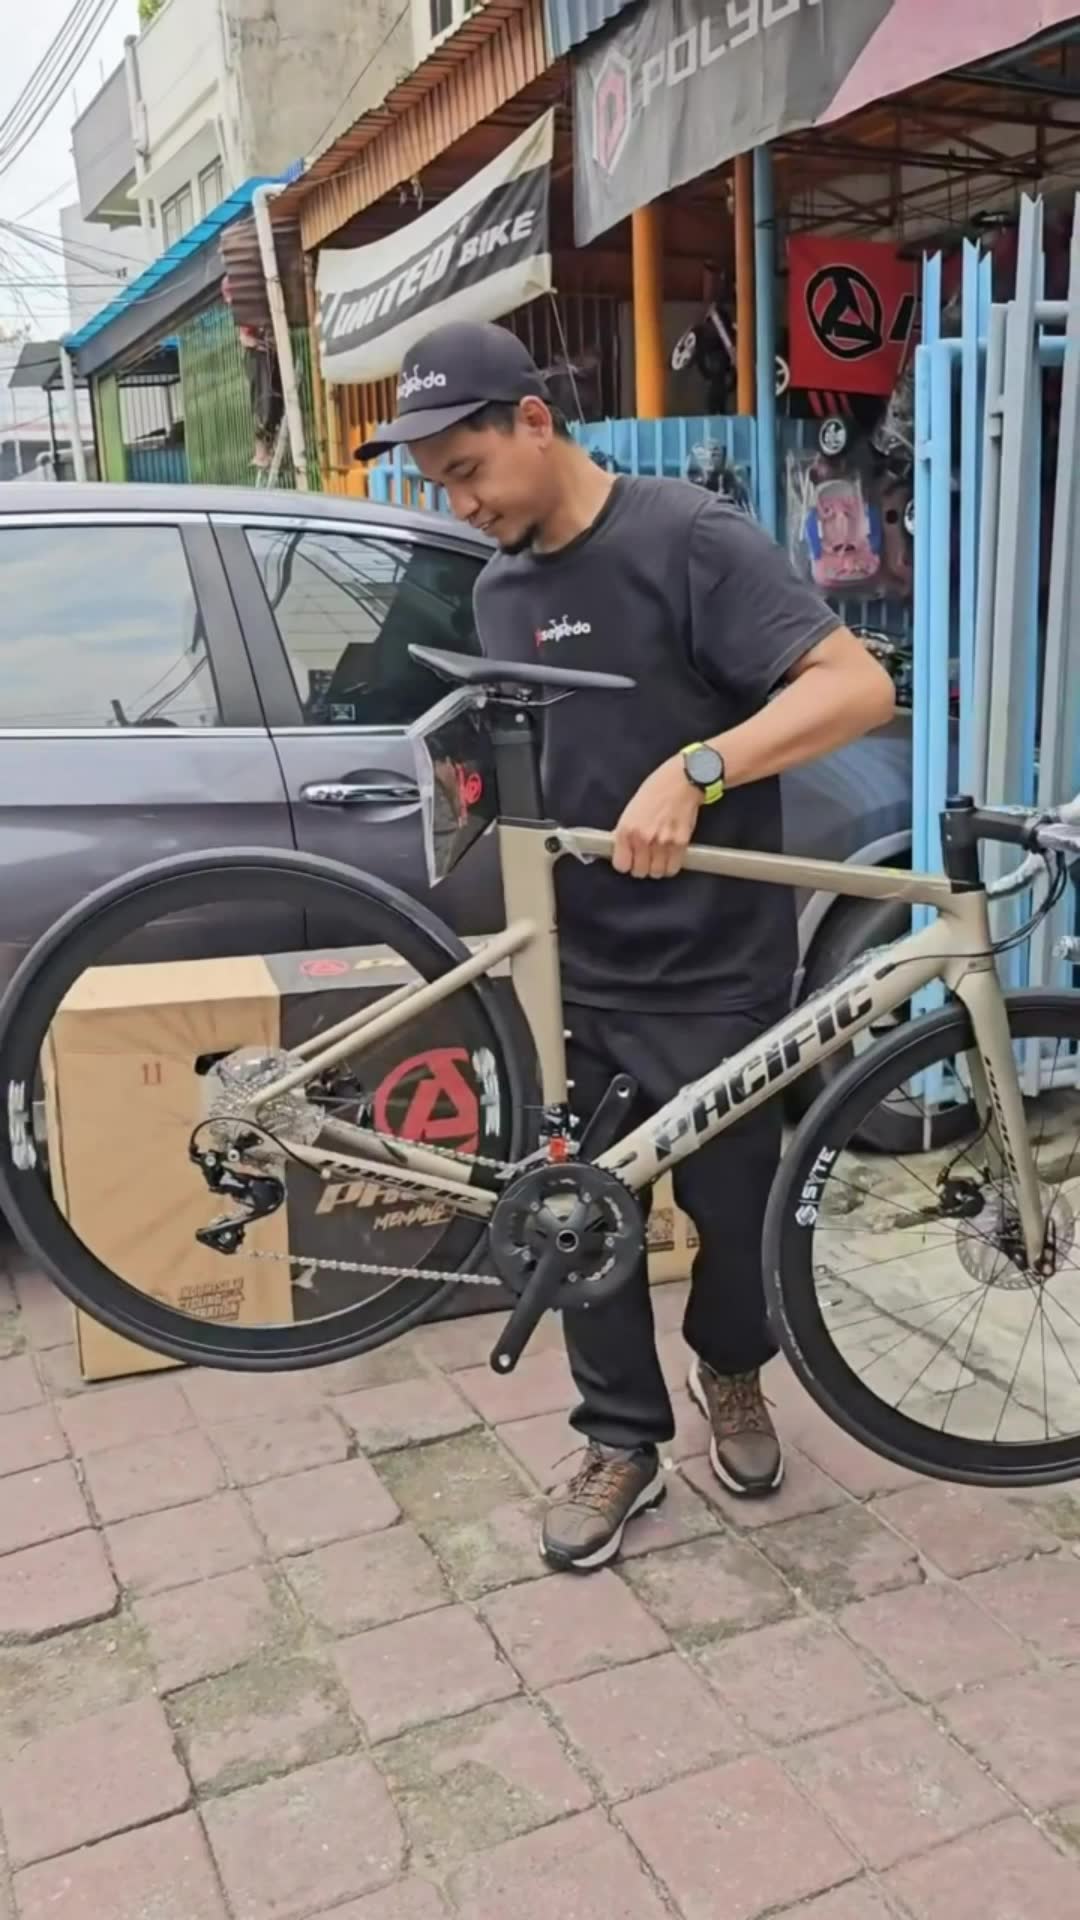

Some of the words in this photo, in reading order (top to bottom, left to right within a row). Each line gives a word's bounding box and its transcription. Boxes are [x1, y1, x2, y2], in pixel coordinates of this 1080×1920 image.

[642, 0, 821, 107] POLY
[332, 235, 457, 339] UNITED
[458, 210, 536, 268] BIKE
[653, 984, 873, 1161] PACIFIC
[801, 1146, 837, 1200] SYTE
